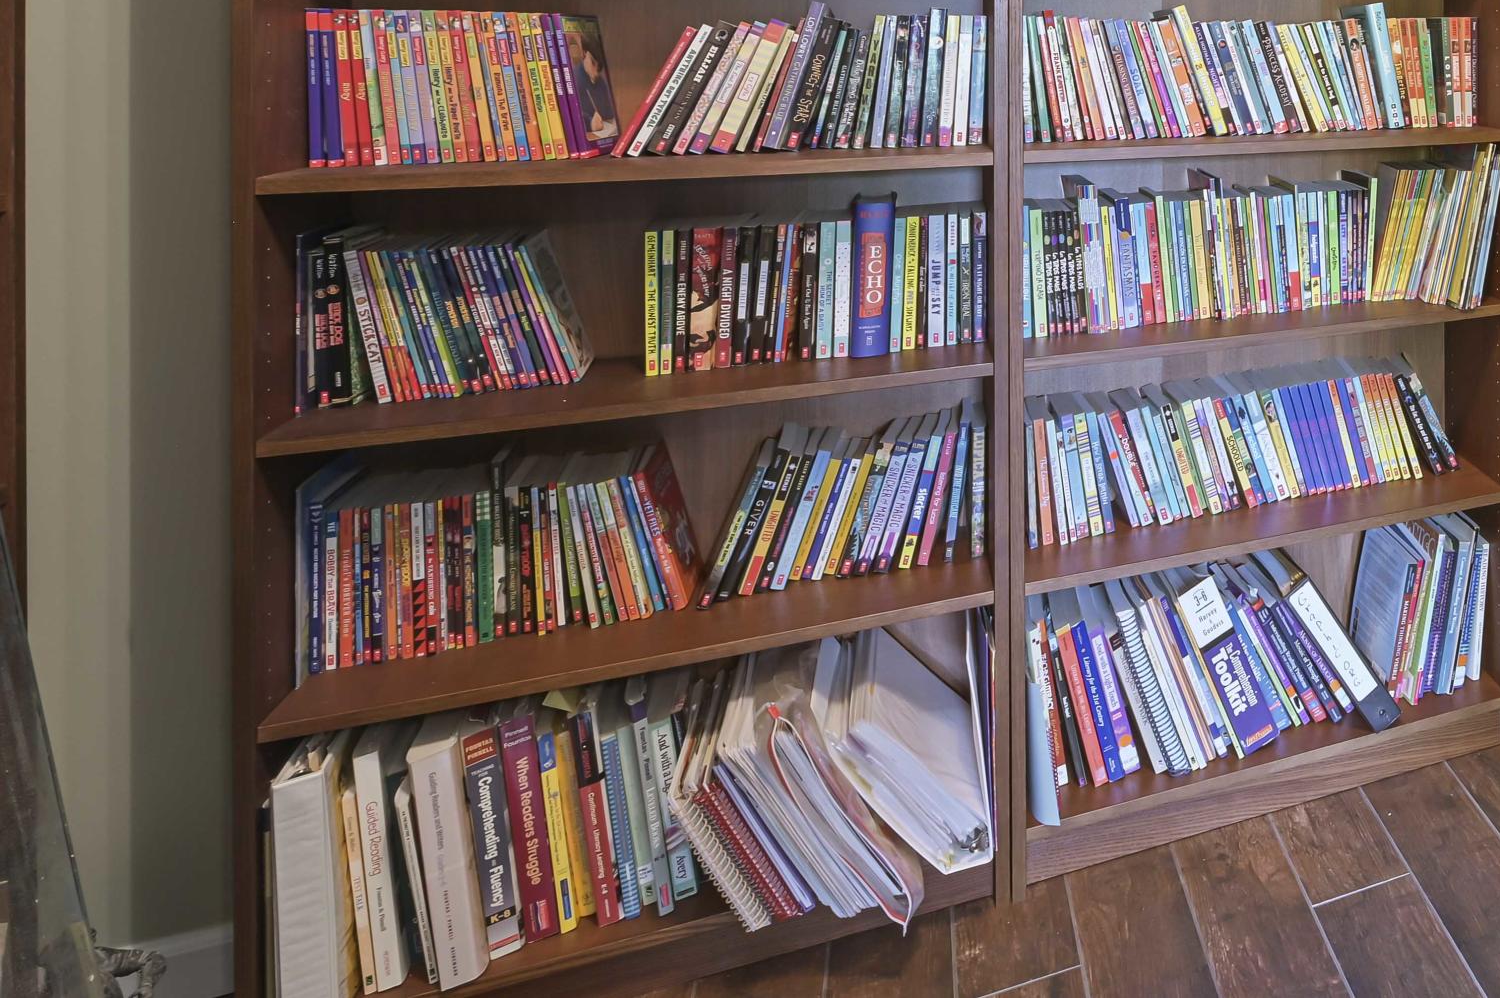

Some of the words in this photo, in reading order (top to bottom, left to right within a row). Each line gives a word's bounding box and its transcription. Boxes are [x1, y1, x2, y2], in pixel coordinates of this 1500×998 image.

[803, 15, 816, 33] LOIS
[795, 33, 811, 59] LOWRY
[429, 67, 442, 88] Henry
[694, 44, 718, 83] ELIJAH
[806, 52, 826, 90] CONNECT
[1260, 35, 1281, 75] PRINCESS
[1272, 72, 1293, 108] ACADEMY
[1393, 59, 1408, 100] Tangerine
[1442, 55, 1453, 96] LOSER
[1128, 66, 1145, 97] SOAR
[793, 99, 813, 124] STARS
[646, 235, 655, 277] GEMEINHART
[930, 258, 942, 285] JUMP
[1118, 242, 1136, 298] FANTASMAS
[720, 276, 733, 302] NIGHT
[865, 244, 884, 305] ECHO
[646, 289, 656, 301] THE
[931, 297, 941, 315] SKY
[357, 308, 376, 342] STICK
[647, 304, 656, 330] HONEST
[717, 303, 731, 339] DIVIDED
[365, 342, 381, 365] CAT
[647, 332, 656, 354] TRUTH
[1120, 437, 1137, 468] DOUBLE
[1227, 434, 1244, 473] SCHOOLED
[880, 466, 899, 499] SNICKER
[898, 462, 918, 496] SNICKER
[742, 498, 764, 536] GIVER
[869, 504, 887, 533] MAGIC
[888, 500, 906, 528] MAGIC
[911, 486, 928, 520] slacker
[760, 508, 780, 544] UNGIFTED
[326, 548, 334, 575] BOBBY
[327, 590, 335, 615] BRAVE
[1199, 608, 1218, 623] Harvey
[1080, 656, 1094, 678] Literacy
[1086, 677, 1095, 686] for
[1211, 647, 1248, 716] Toolkit
[1230, 649, 1258, 706] Comprehension
[1089, 685, 1097, 694] the
[1091, 694, 1101, 706] 21st
[1092, 704, 1106, 727] Century
[514, 756, 531, 790] When
[659, 751, 671, 771] with
[364, 801, 379, 835] Guided
[475, 775, 501, 859] Comprehending
[519, 790, 537, 838] Readers
[366, 836, 384, 876] Reading
[521, 838, 543, 886] Struggle
[672, 855, 689, 880] Avery
[486, 864, 506, 907] Fluency
